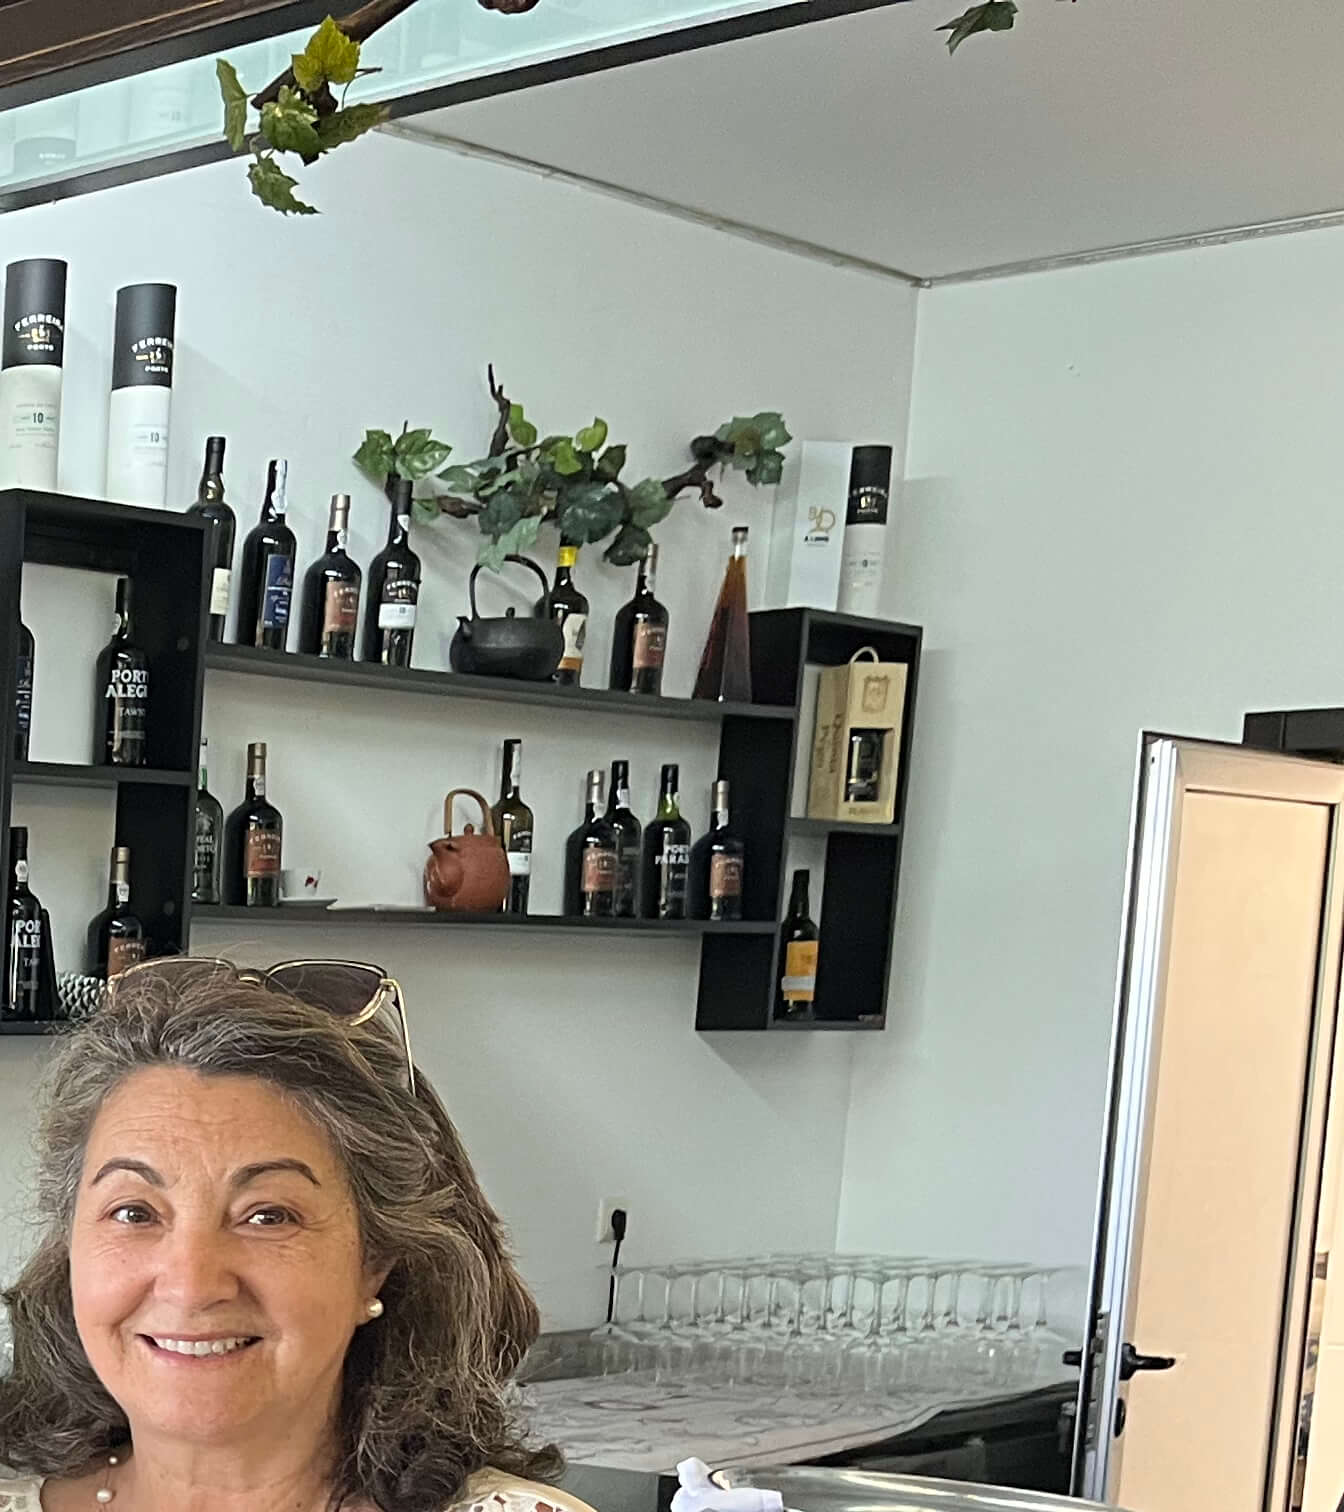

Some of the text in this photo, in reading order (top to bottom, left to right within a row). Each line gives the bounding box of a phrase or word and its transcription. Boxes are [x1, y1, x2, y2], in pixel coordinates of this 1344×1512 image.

[32, 412, 44, 424] 10
[150, 432, 160, 443] 10
[111, 669, 149, 683] PORT
